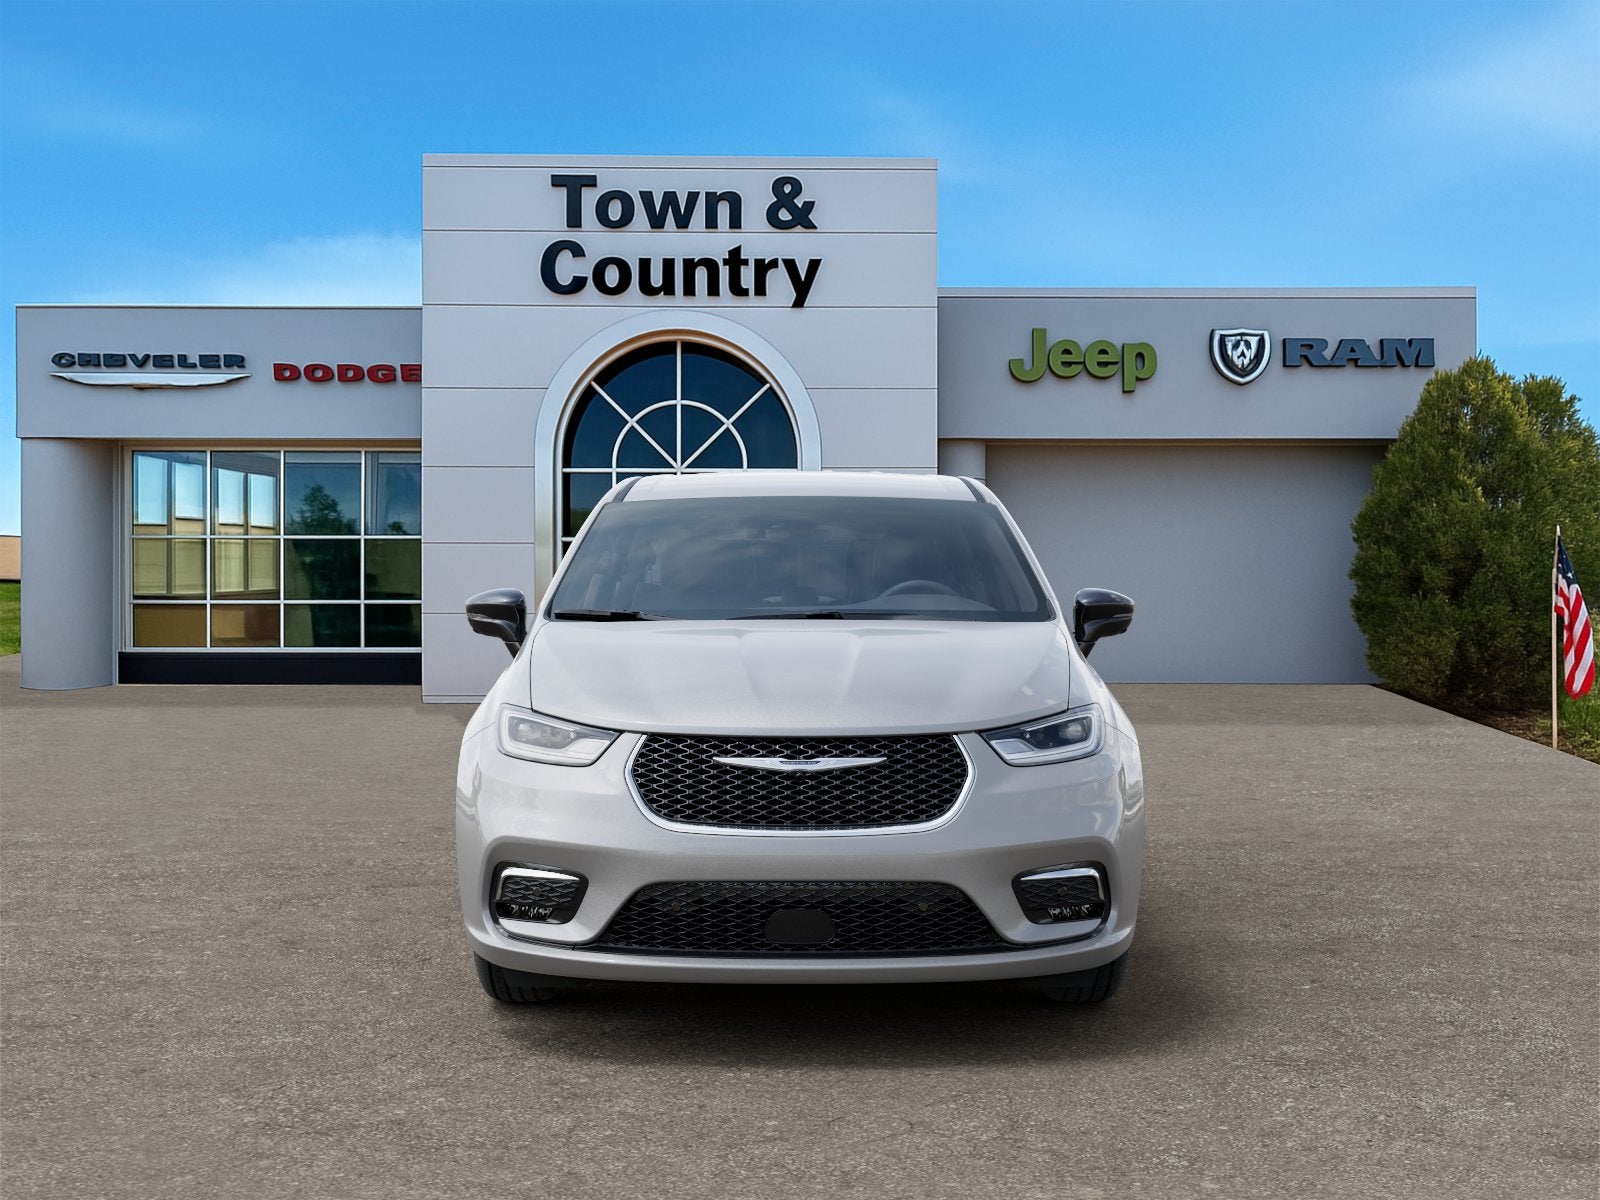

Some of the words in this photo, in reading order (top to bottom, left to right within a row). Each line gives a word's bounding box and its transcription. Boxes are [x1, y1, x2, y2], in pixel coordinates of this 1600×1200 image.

[550, 174, 743, 230] Town
[766, 175, 818, 230] &
[540, 239, 823, 309] Country
[272, 362, 422, 383] DODGE
[1009, 328, 1158, 393] Jeep
[1282, 337, 1436, 368] RAM
